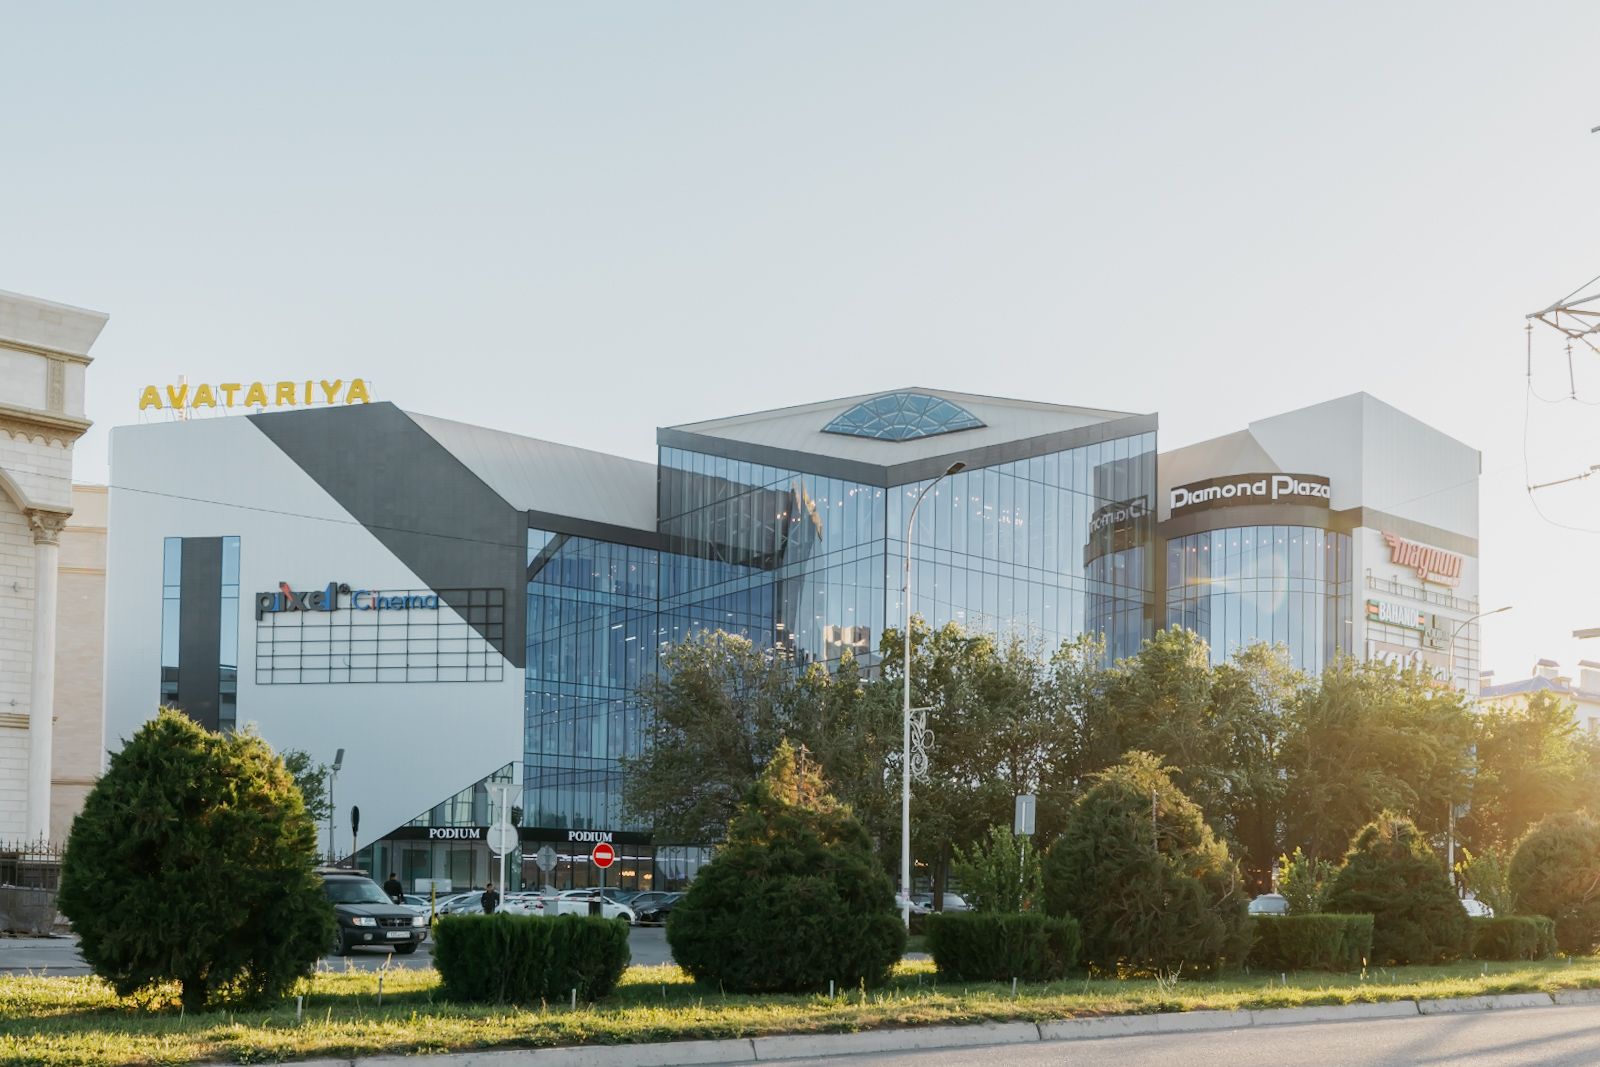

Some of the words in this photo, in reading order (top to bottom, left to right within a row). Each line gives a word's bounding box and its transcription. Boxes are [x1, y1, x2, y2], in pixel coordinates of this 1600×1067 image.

[139, 378, 370, 410] AVATARIYA
[1170, 479, 1266, 510] Diamond
[1271, 475, 1331, 500] Plaza
[256, 582, 337, 621] pixel
[352, 589, 438, 611] Cinema
[1378, 602, 1418, 627] BAHANDI
[429, 828, 480, 839] PODIUM
[568, 831, 612, 842] PODIUM
